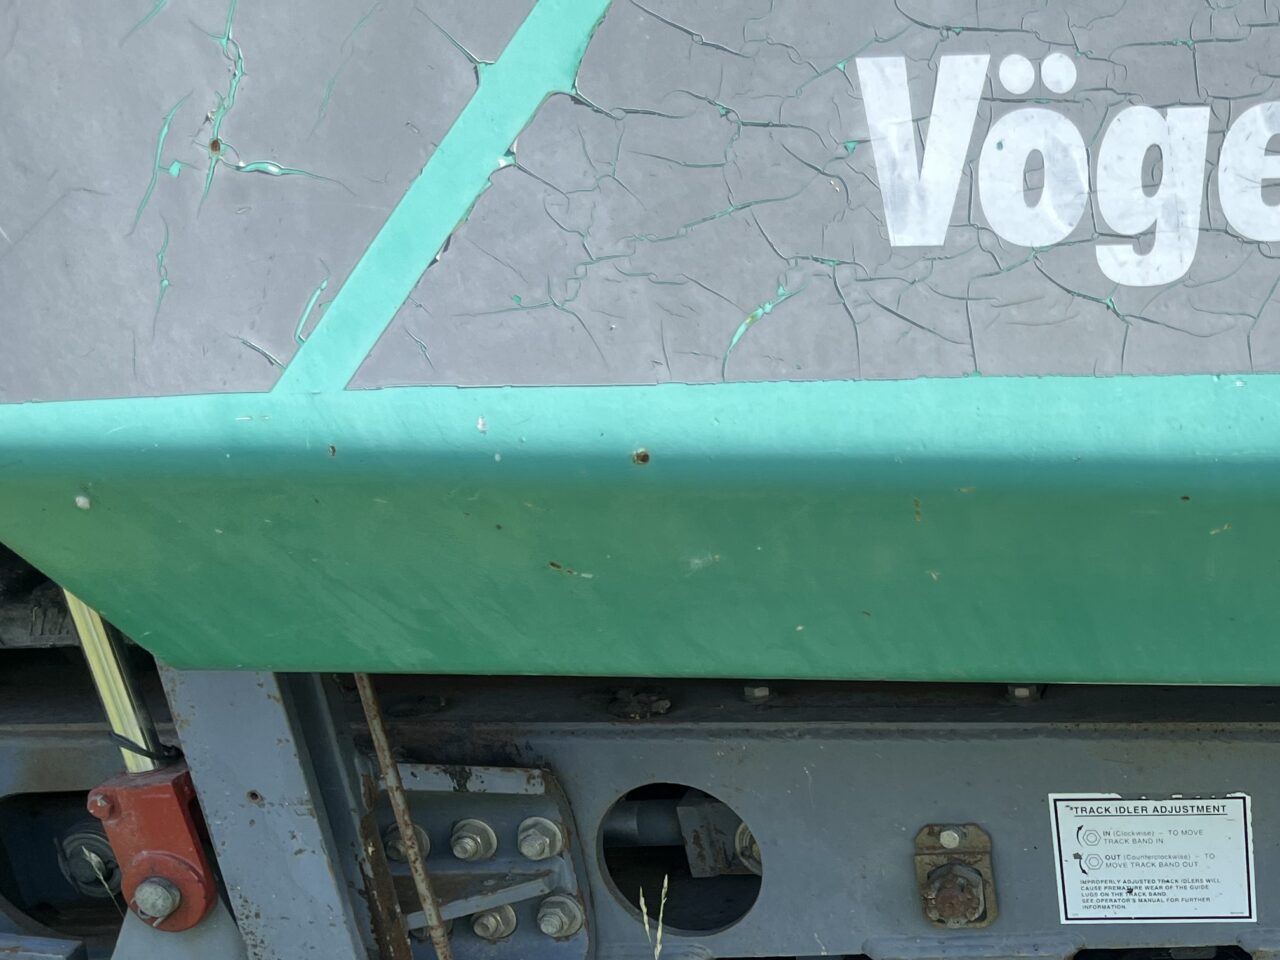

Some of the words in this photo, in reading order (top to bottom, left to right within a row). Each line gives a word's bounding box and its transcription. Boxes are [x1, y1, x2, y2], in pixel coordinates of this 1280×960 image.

[1074, 805, 1112, 815] TRACK
[1115, 805, 1149, 814] IDLER
[1152, 804, 1227, 814] ADJUSTMENT
[1103, 837, 1130, 845] TRACK
[1205, 852, 1216, 860] TO
[1105, 861, 1128, 869] MOVE
[1158, 860, 1181, 868] BAND
[1182, 860, 1199, 868] OUT
